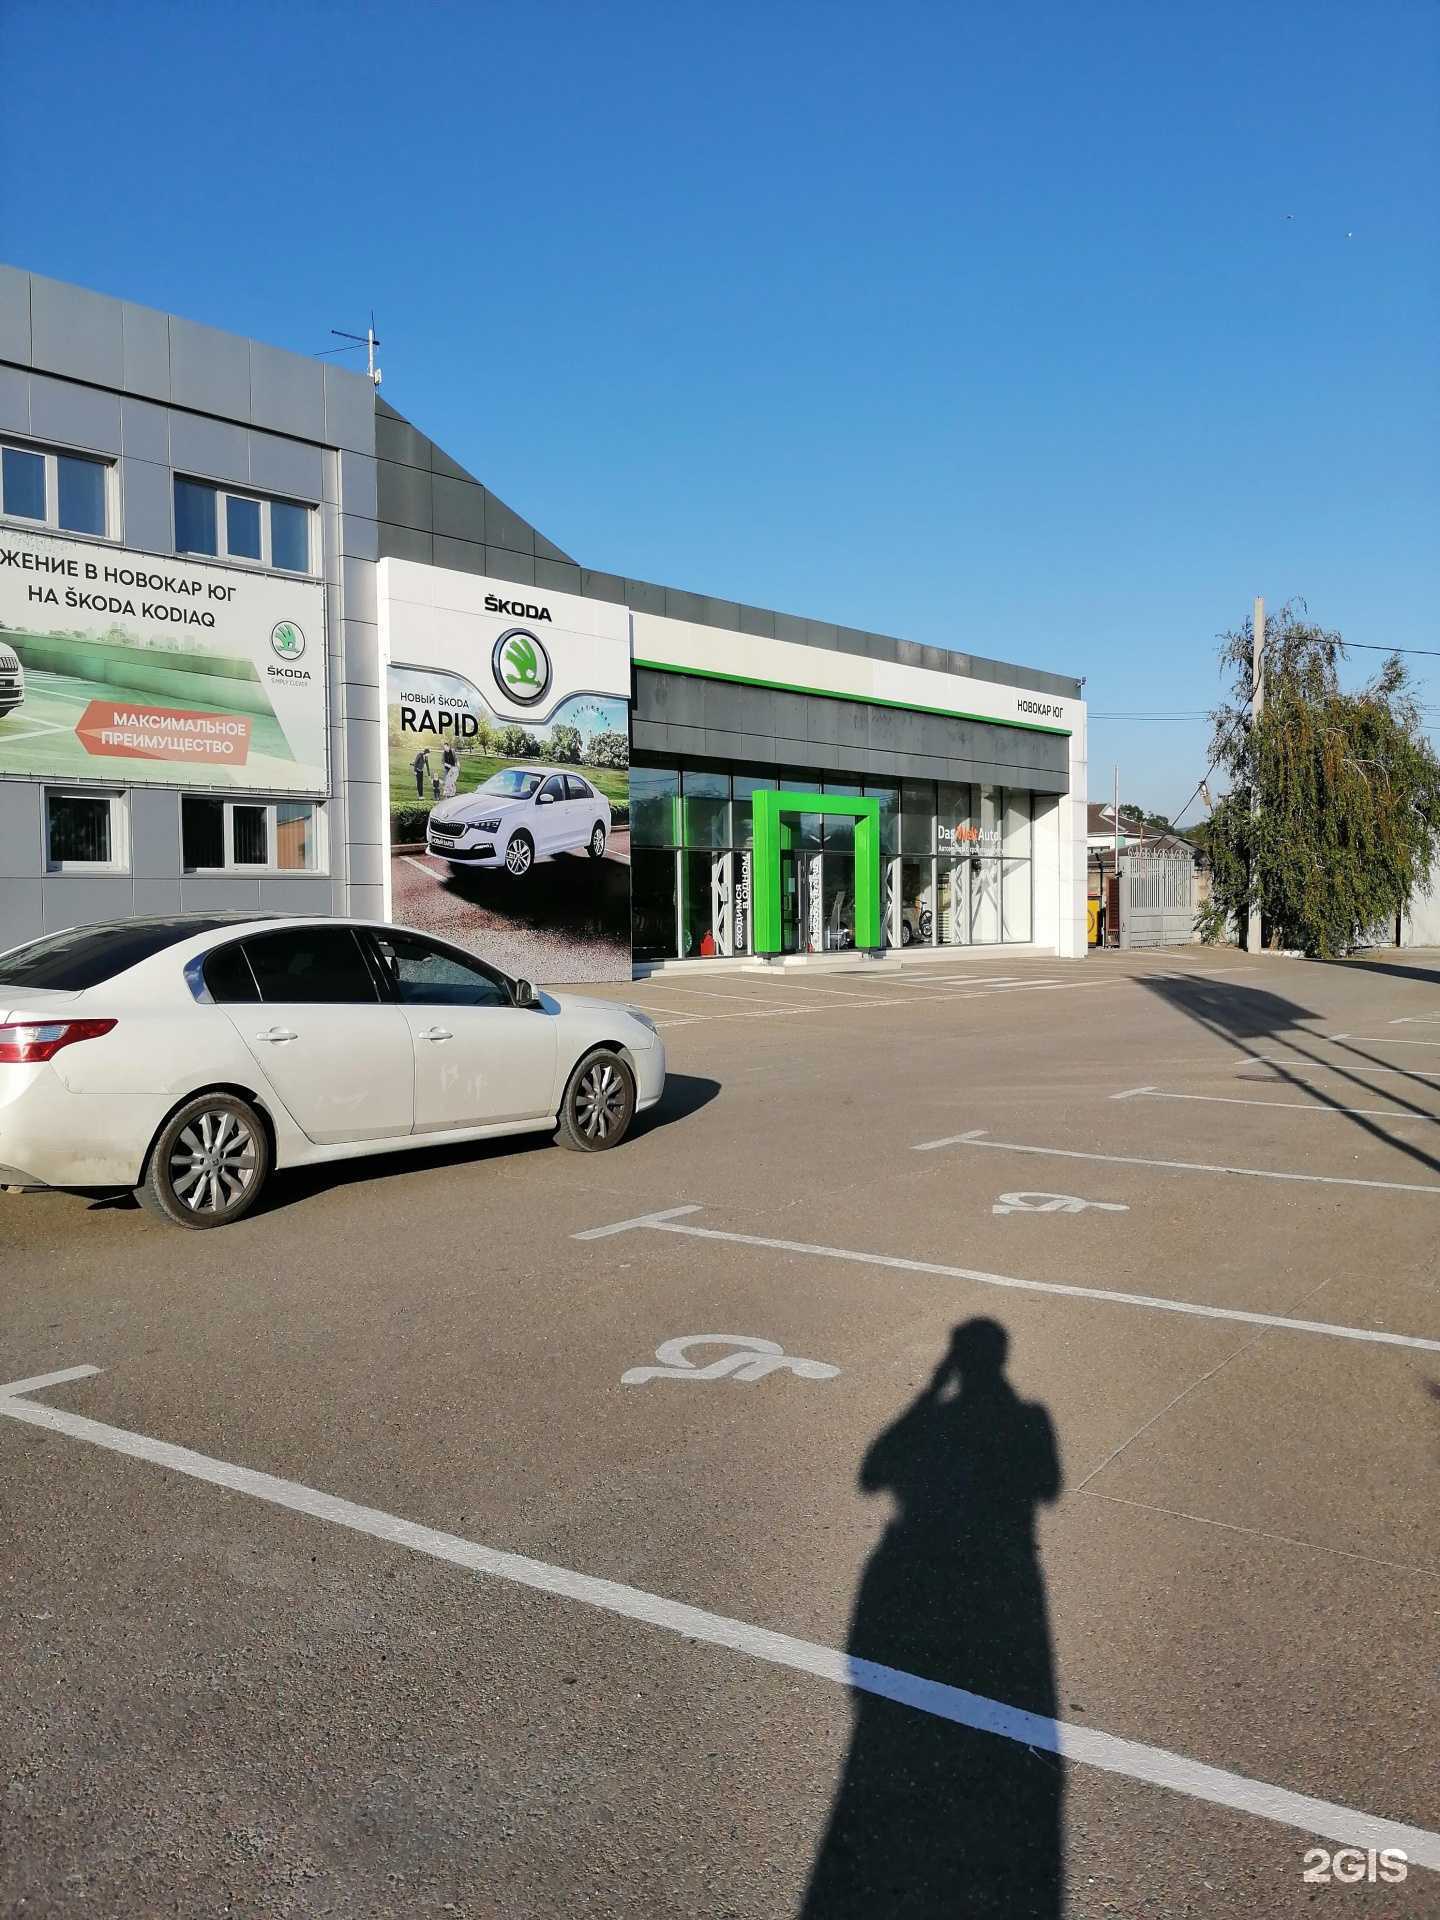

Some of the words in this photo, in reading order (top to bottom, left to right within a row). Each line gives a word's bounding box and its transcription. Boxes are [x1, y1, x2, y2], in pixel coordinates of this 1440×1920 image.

[85, 563, 98, 579] В
[104, 566, 202, 596] НОВОКАР
[208, 584, 237, 601] ЮГ
[28, 585, 59, 605] НА
[65, 586, 136, 616] ŠKODA
[142, 602, 215, 627] KODIAQ
[484, 593, 552, 622] ŠKODA
[267, 664, 312, 680] ŠKODA
[400, 692, 436, 705] НОВЫЙ
[438, 694, 469, 708] ŠKODA
[1017, 699, 1052, 716] НОВОКАР
[1052, 706, 1064, 718] ЮГ
[113, 712, 247, 737] МАКСИМАЛЬНОЕ
[401, 706, 478, 737] RAPID
[101, 731, 234, 754] ПРЕИМУЩЕСТВО
[735, 884, 744, 948] СХОДИМСЯ
